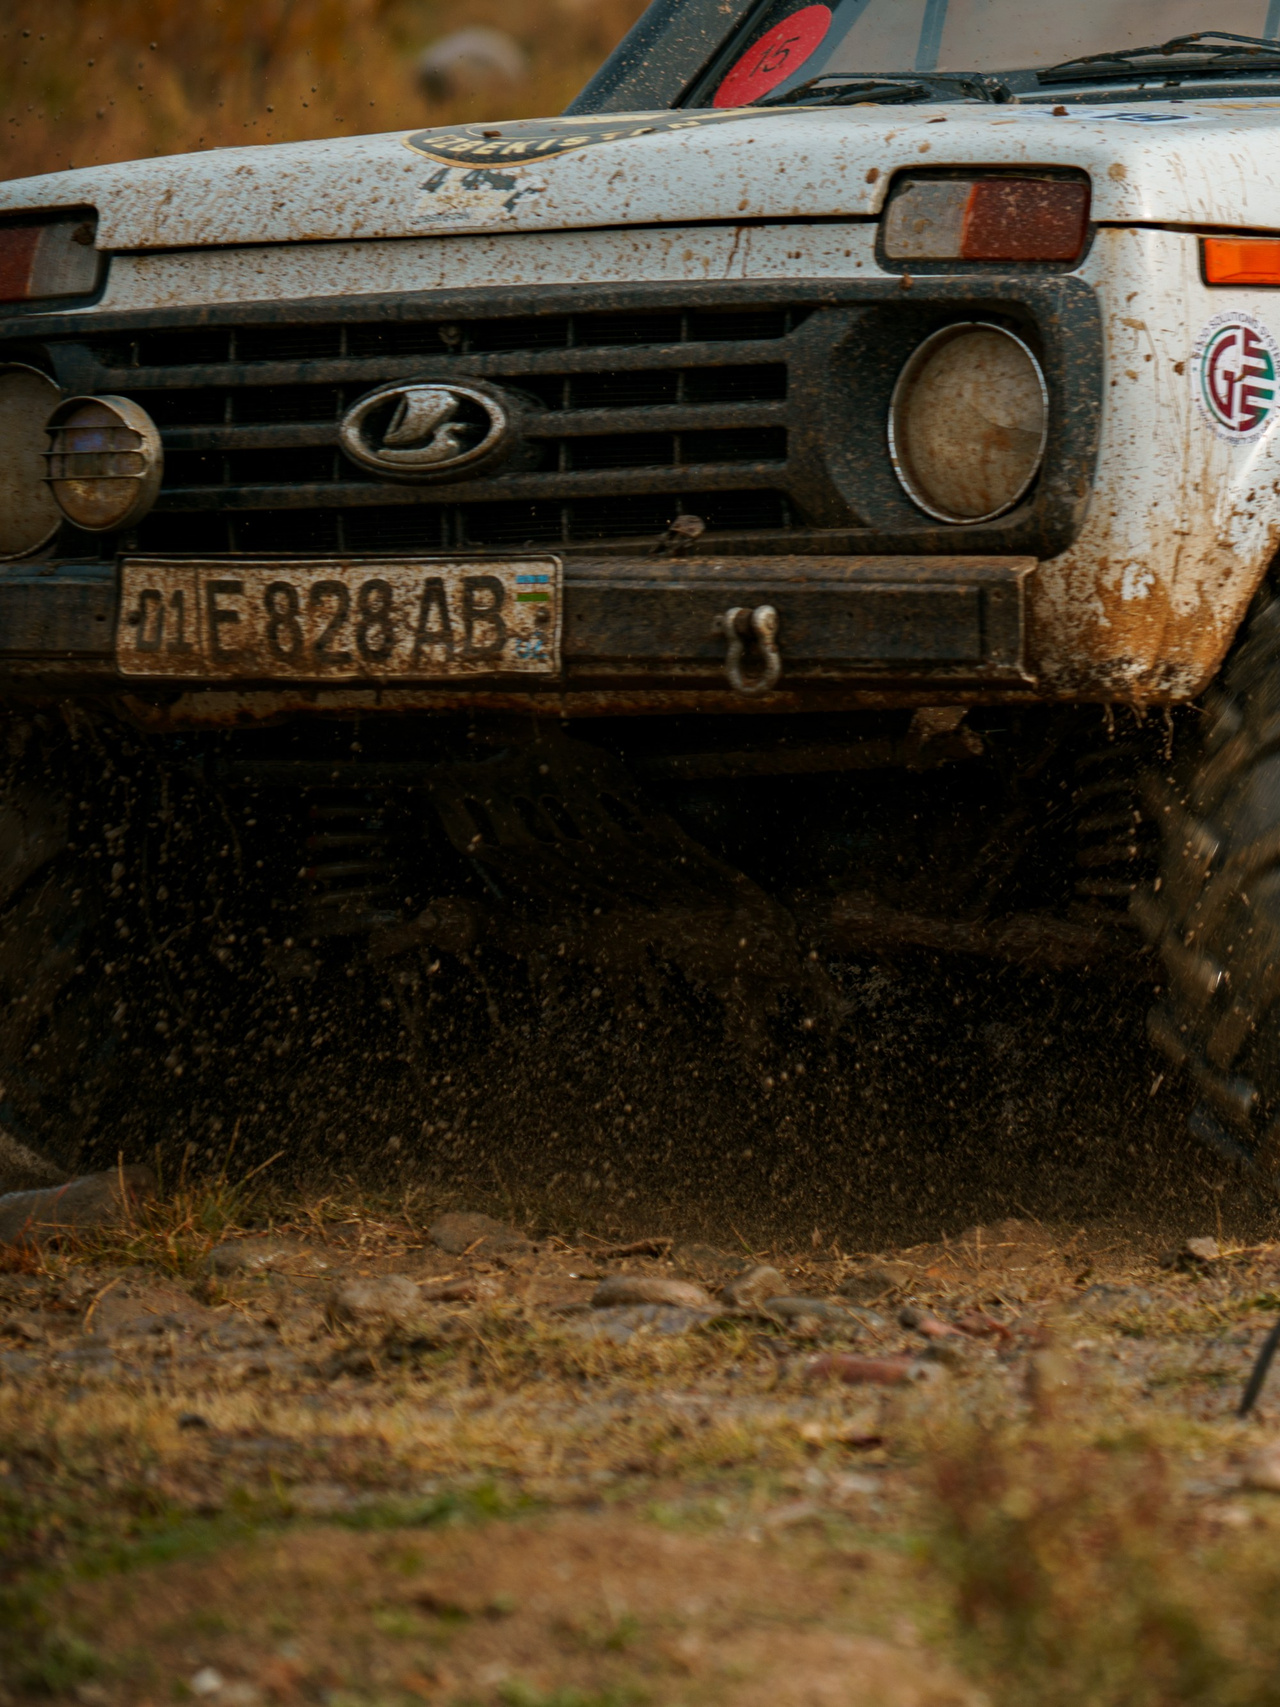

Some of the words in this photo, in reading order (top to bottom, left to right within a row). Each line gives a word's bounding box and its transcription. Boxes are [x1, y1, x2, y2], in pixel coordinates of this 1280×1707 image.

[749, 36, 800, 77] 15
[422, 119, 701, 155] UZBEKISTAN
[1209, 311, 1261, 330] SOLUTIONS
[137, 588, 193, 653] 01
